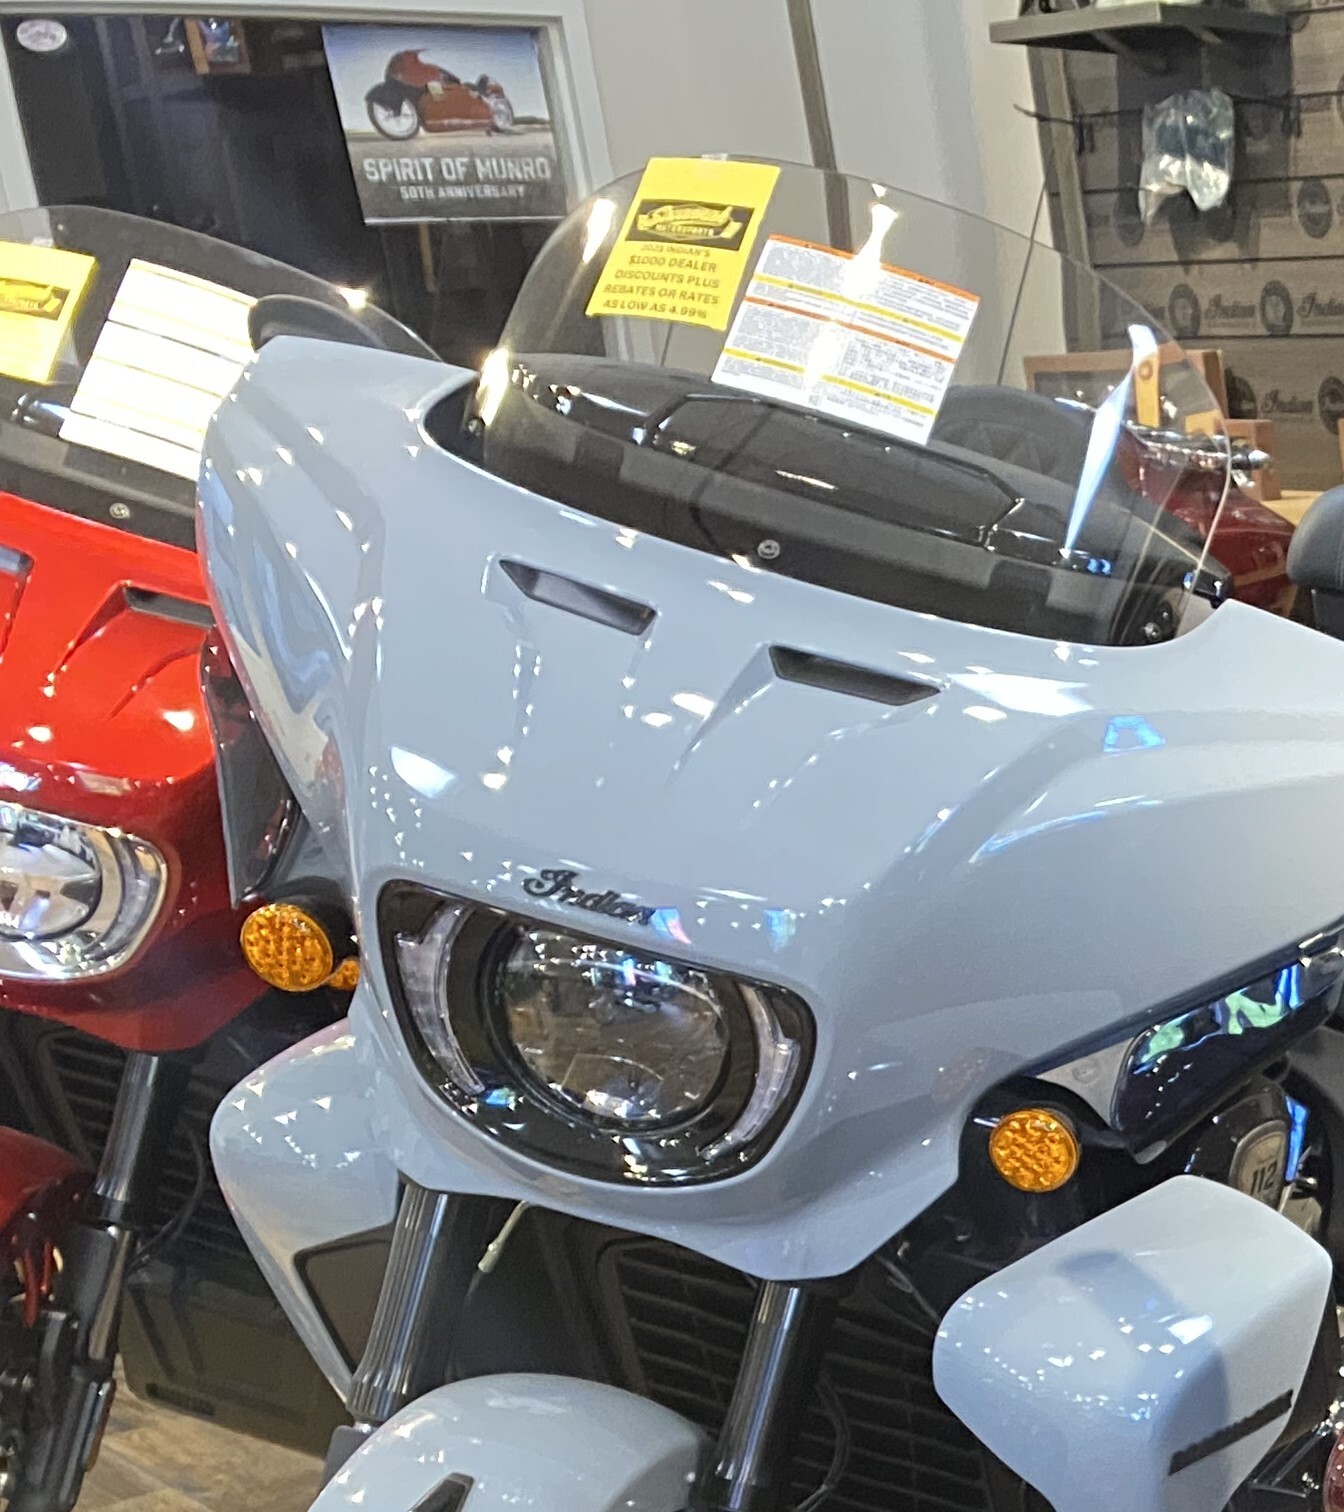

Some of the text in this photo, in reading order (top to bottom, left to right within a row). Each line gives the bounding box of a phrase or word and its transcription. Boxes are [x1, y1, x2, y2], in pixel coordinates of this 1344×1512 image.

[362, 156, 551, 182] SPIRIT OF MUNRO
[400, 184, 526, 200] 50TH ANNIVERSARY
[629, 255, 717, 273] $1000 DEALER
[614, 269, 720, 289] DISCOUNTS PLUS
[603, 284, 720, 305] REBATES OR RATES
[603, 299, 619, 309] AS
[620, 300, 648, 311] LOW
[649, 303, 666, 314] AS
[523, 868, 657, 926] Indian
[1250, 1160, 1278, 1196] 112
